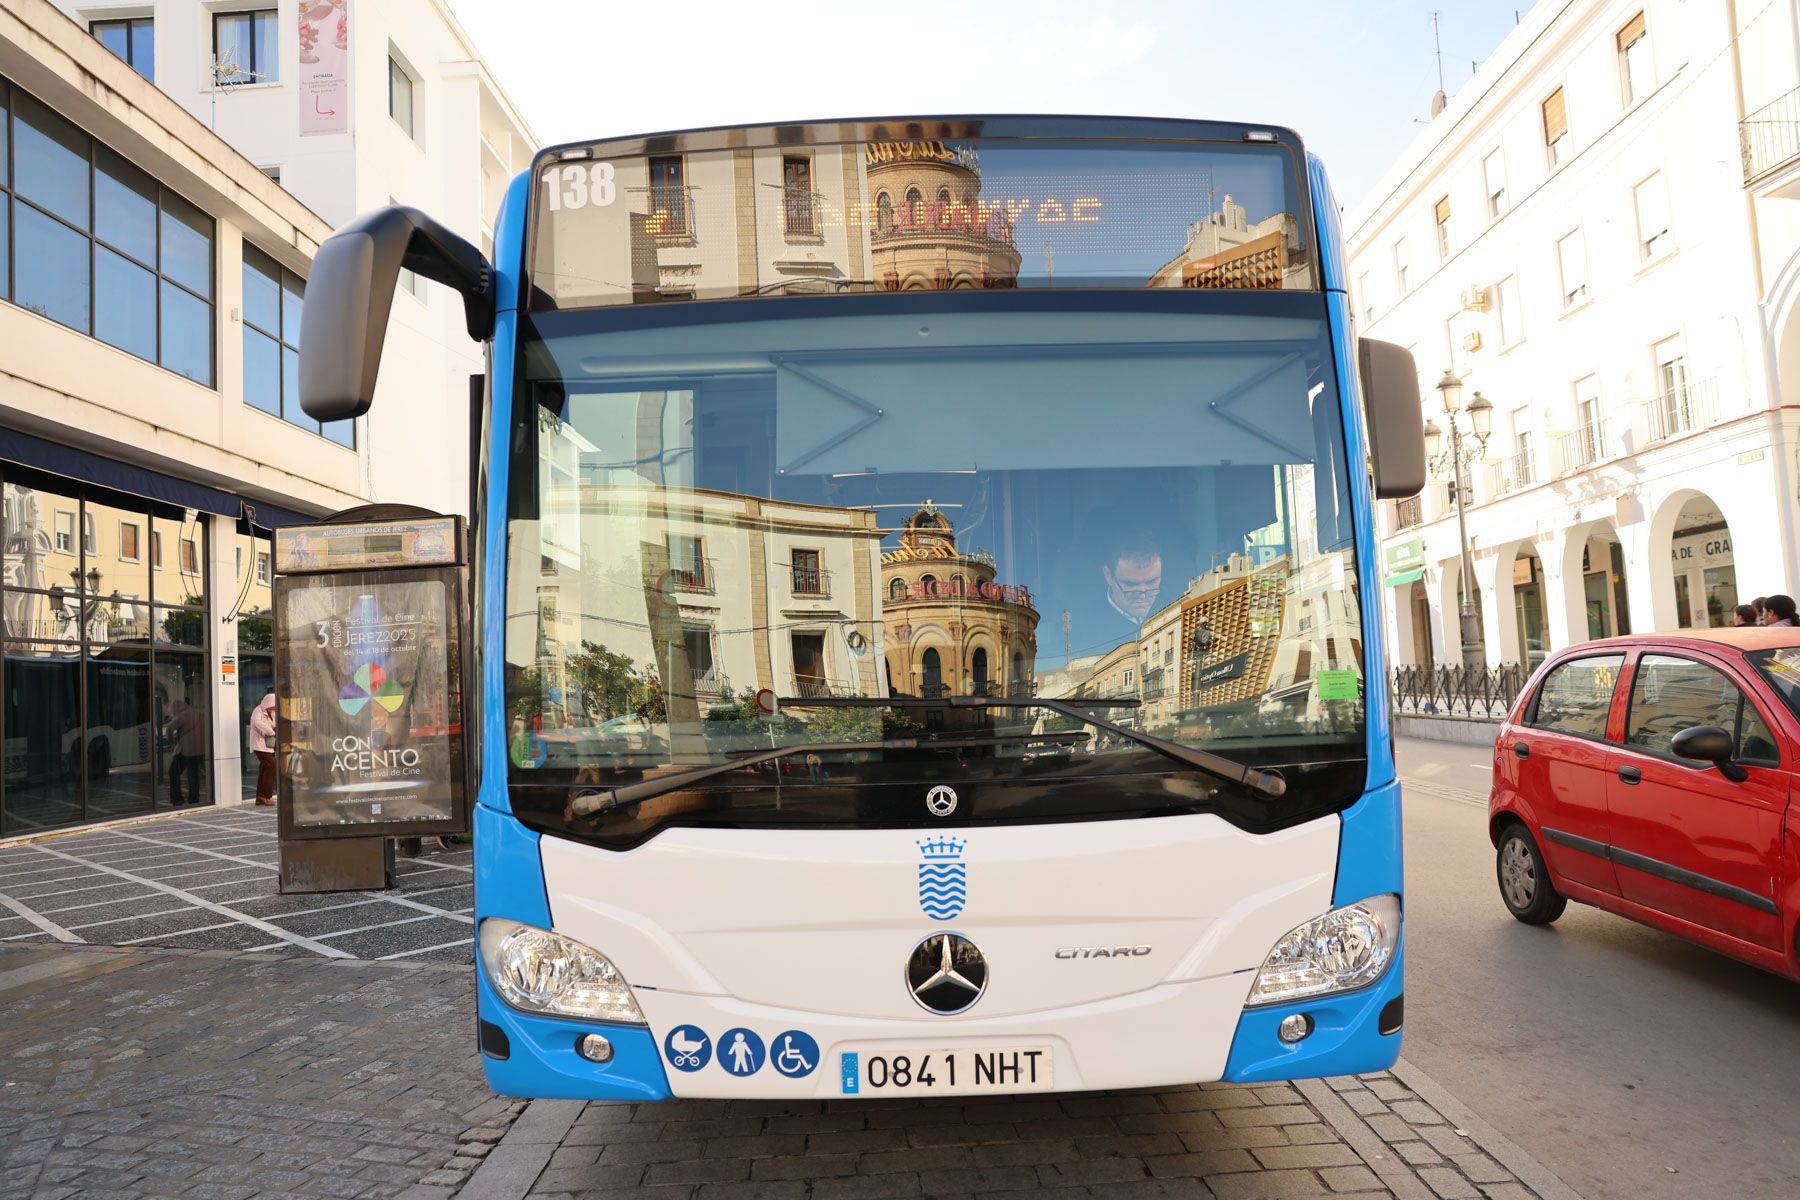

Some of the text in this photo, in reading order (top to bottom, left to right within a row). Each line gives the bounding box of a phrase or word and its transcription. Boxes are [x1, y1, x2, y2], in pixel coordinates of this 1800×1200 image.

[542, 162, 616, 211] 138
[322, 529, 355, 538] AUTOBUSES
[355, 527, 381, 535] URBANOS
[1680, 546, 1692, 559] DE
[346, 612, 415, 626] Festival de Cine
[331, 620, 342, 648] EDICIÓN
[355, 648, 364, 656] 14
[390, 645, 417, 653] octubre
[332, 735, 370, 752] CON
[331, 748, 419, 772] ACENTO
[360, 767, 421, 779] Festival de Cine
[1055, 944, 1152, 959] CITARO
[867, 1050, 1043, 1088] 0841 NHT
[846, 1077, 854, 1087] E
